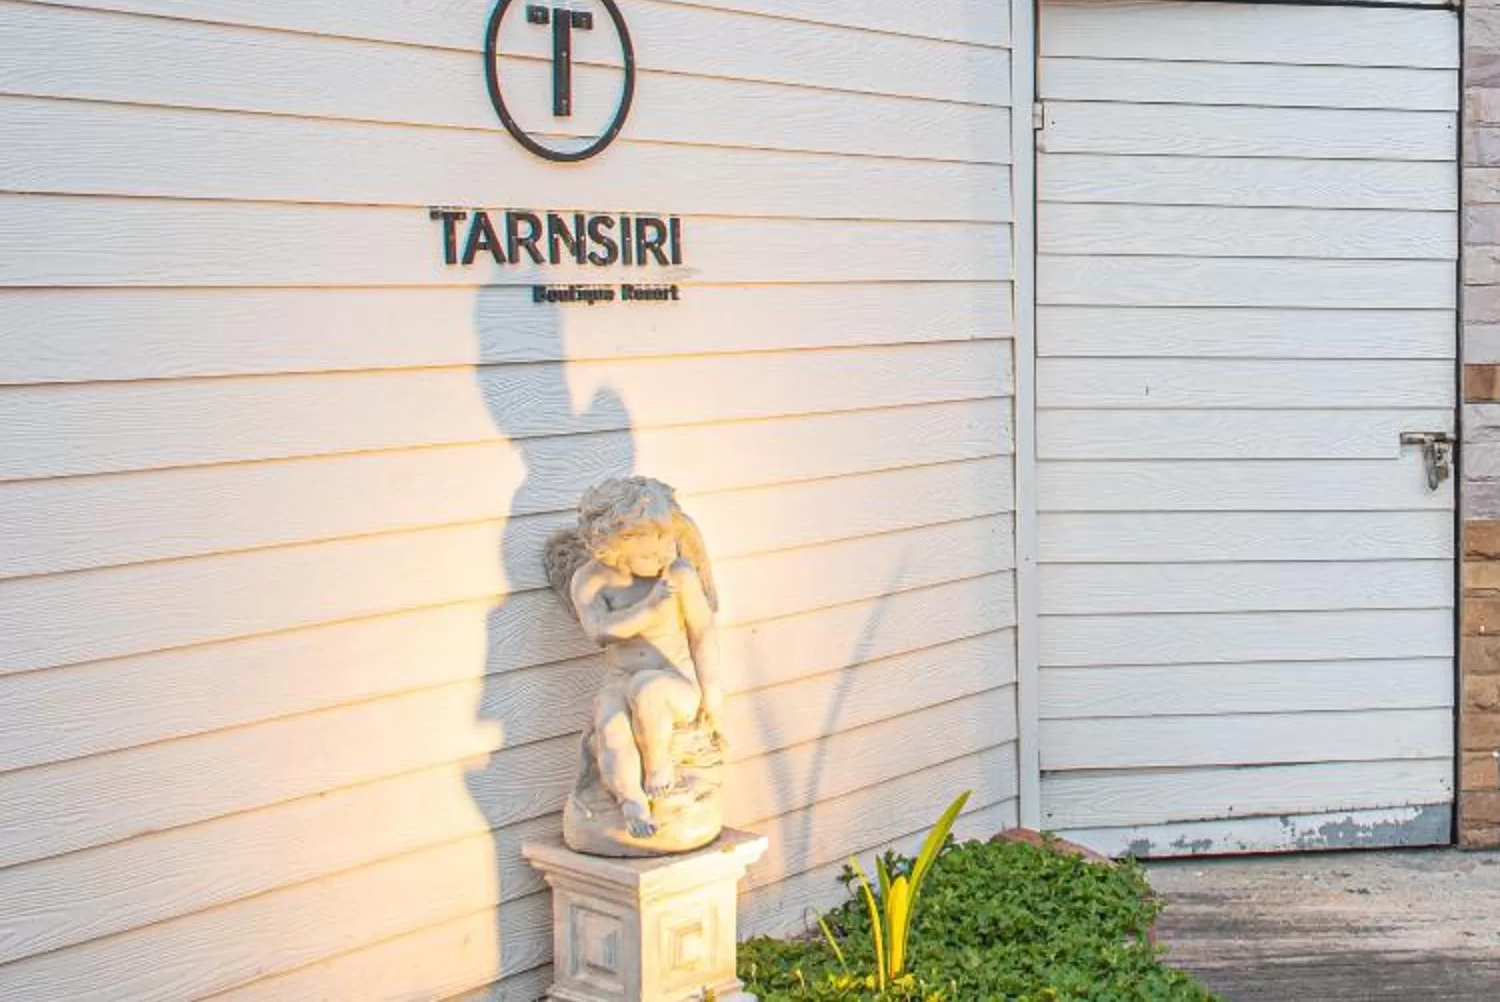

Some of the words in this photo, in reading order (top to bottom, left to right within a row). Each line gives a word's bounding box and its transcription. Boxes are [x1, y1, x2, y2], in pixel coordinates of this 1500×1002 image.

[526, 4, 593, 117] T
[429, 209, 682, 267] TARNSIRI
[532, 284, 615, 305] Boutique
[621, 284, 679, 301] Resort
